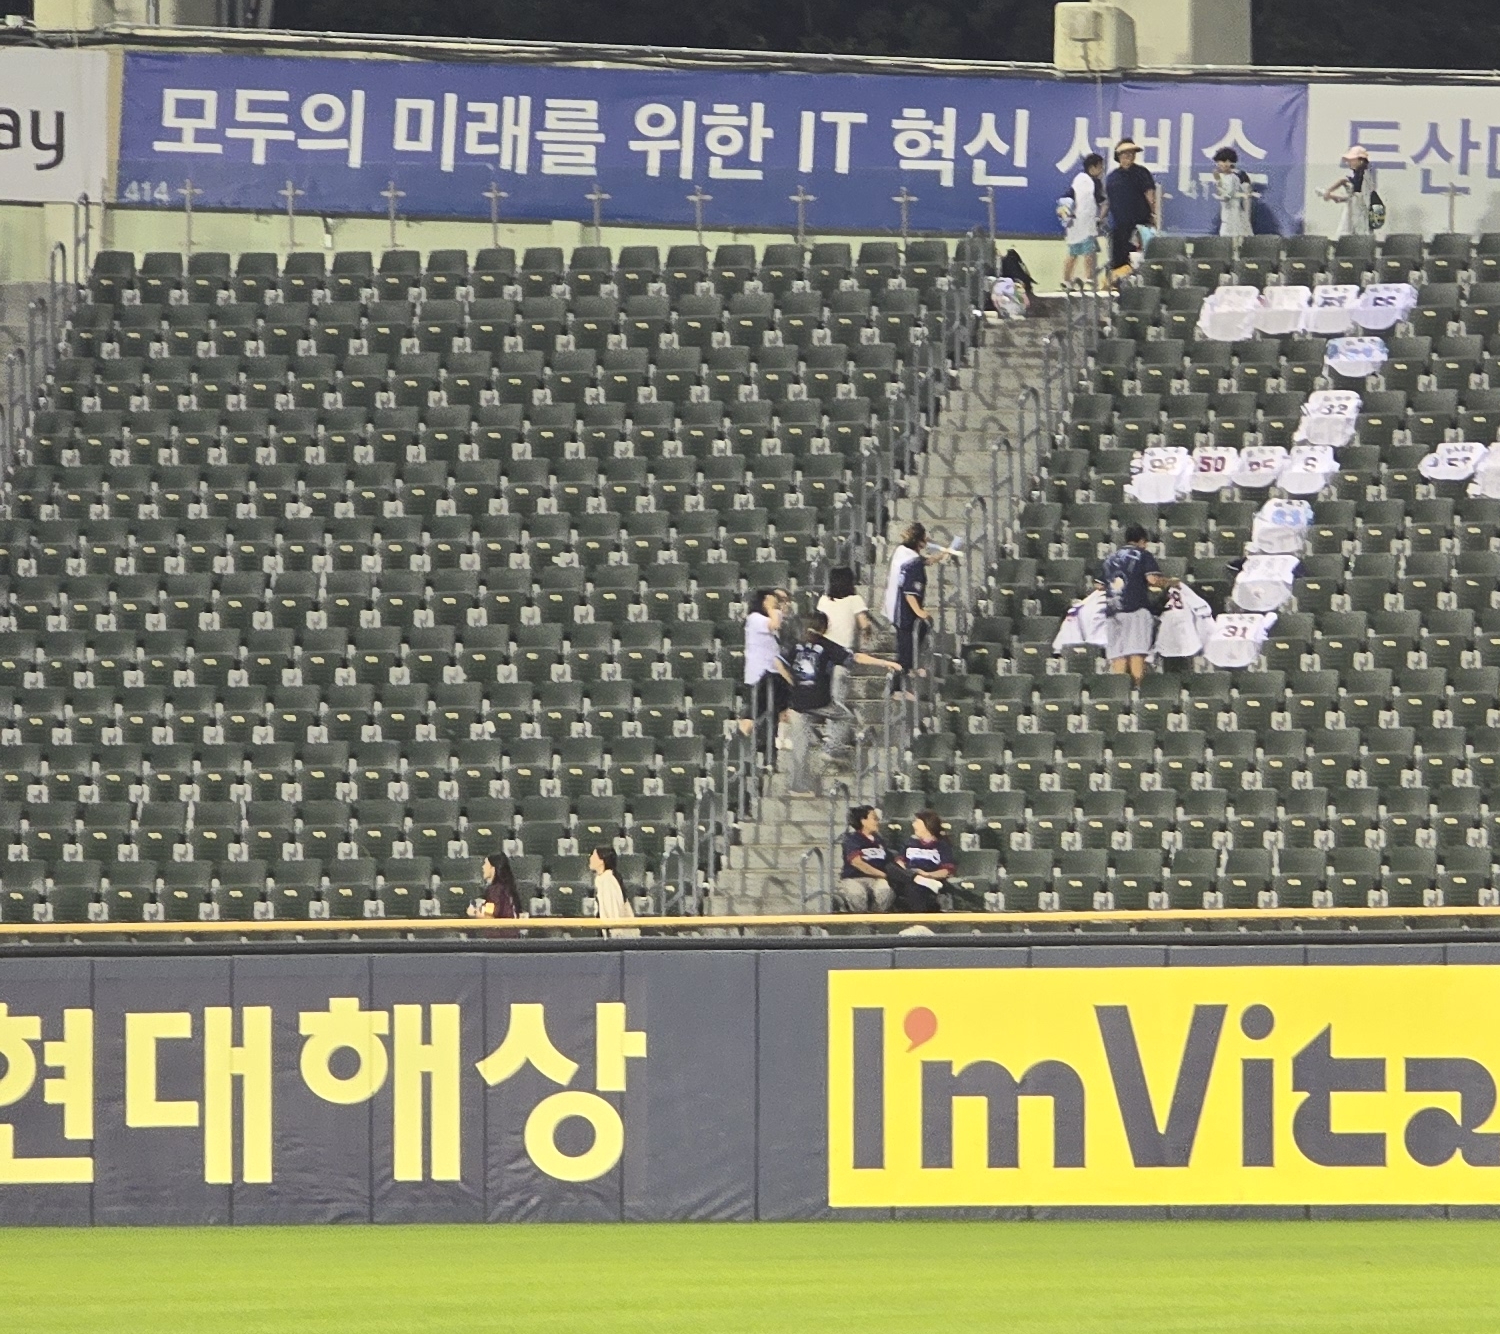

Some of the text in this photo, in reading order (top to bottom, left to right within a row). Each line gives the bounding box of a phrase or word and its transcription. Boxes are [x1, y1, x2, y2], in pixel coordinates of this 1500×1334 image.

[152, 88, 1269, 193] 모두의 미래를 위한 IT 혁신 서비스
[123, 180, 171, 203] 414
[1199, 455, 1227, 473] 50
[0, 996, 647, 1185] 현대해상
